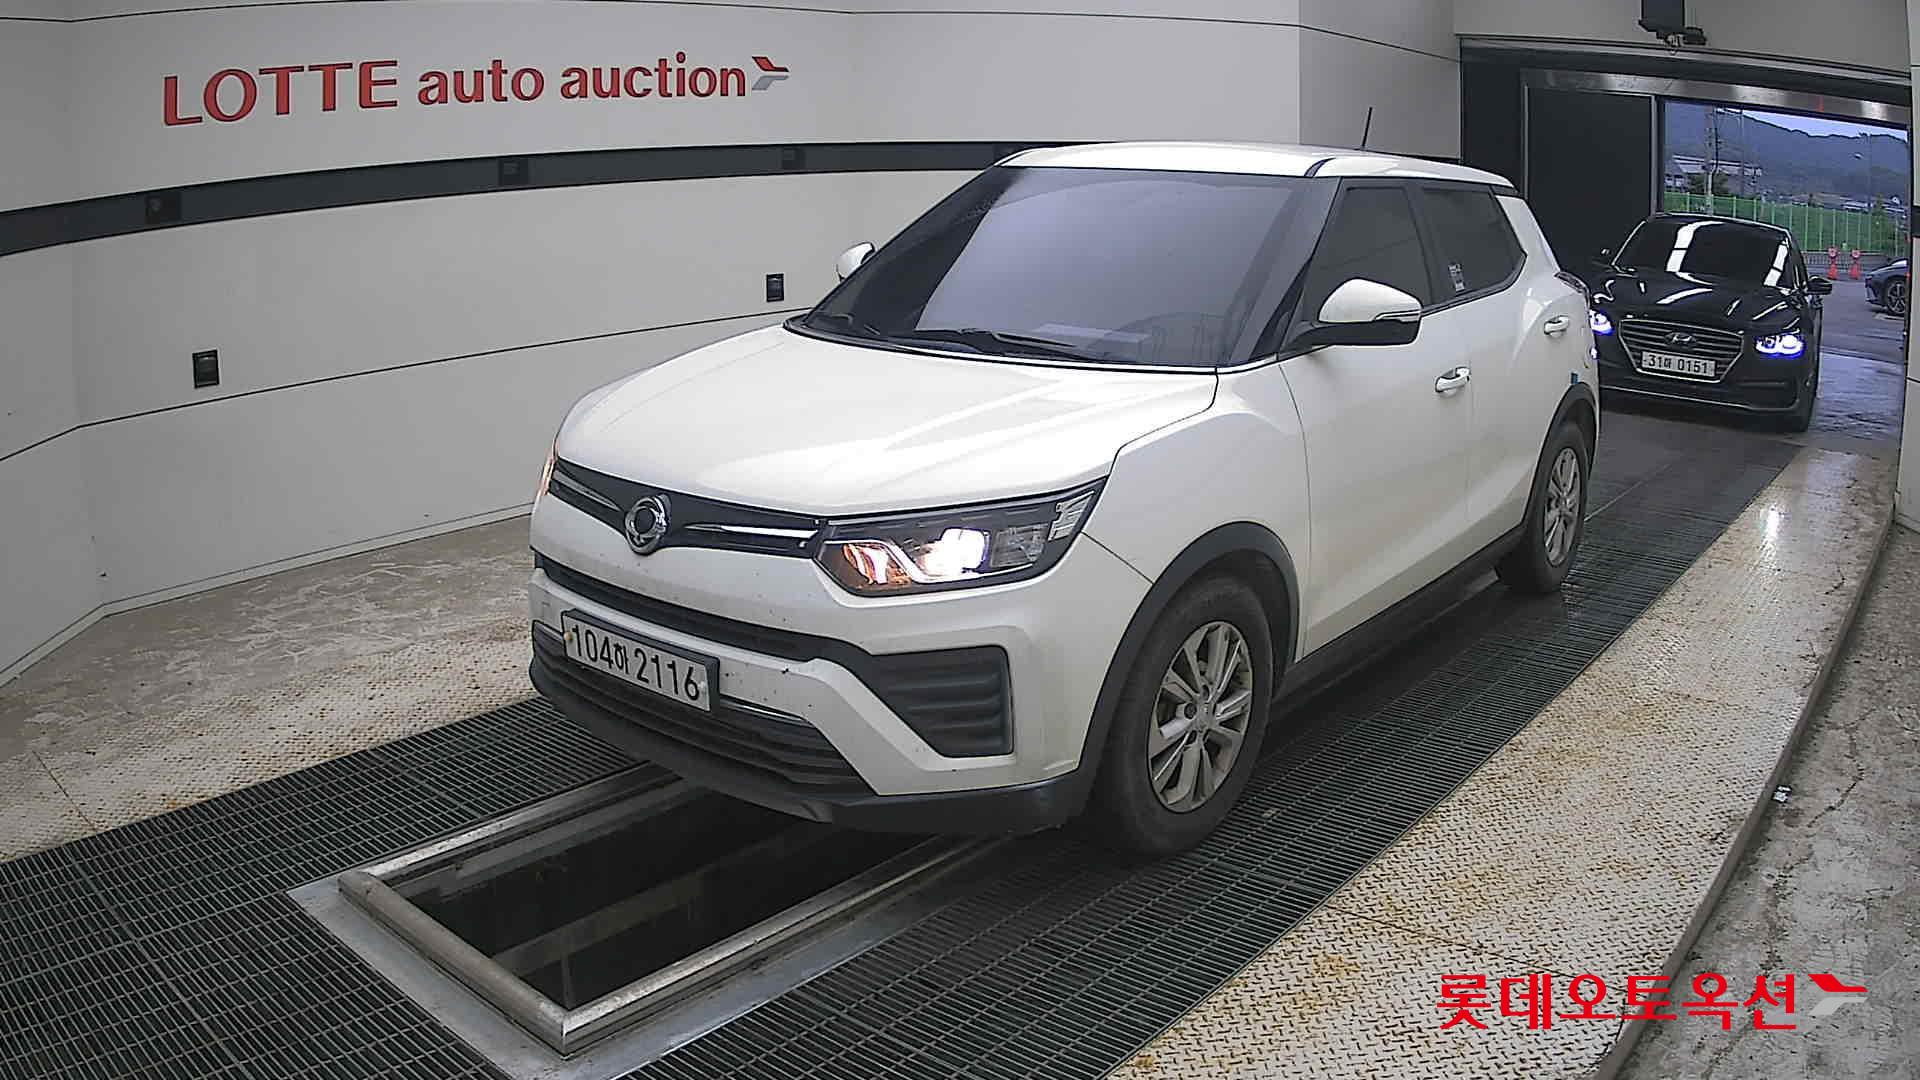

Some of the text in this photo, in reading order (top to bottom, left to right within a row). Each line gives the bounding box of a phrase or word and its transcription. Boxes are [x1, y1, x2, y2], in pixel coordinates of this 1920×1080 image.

[163, 52, 747, 126] LOTTE auto auction
[634, 648, 700, 701] 2116
